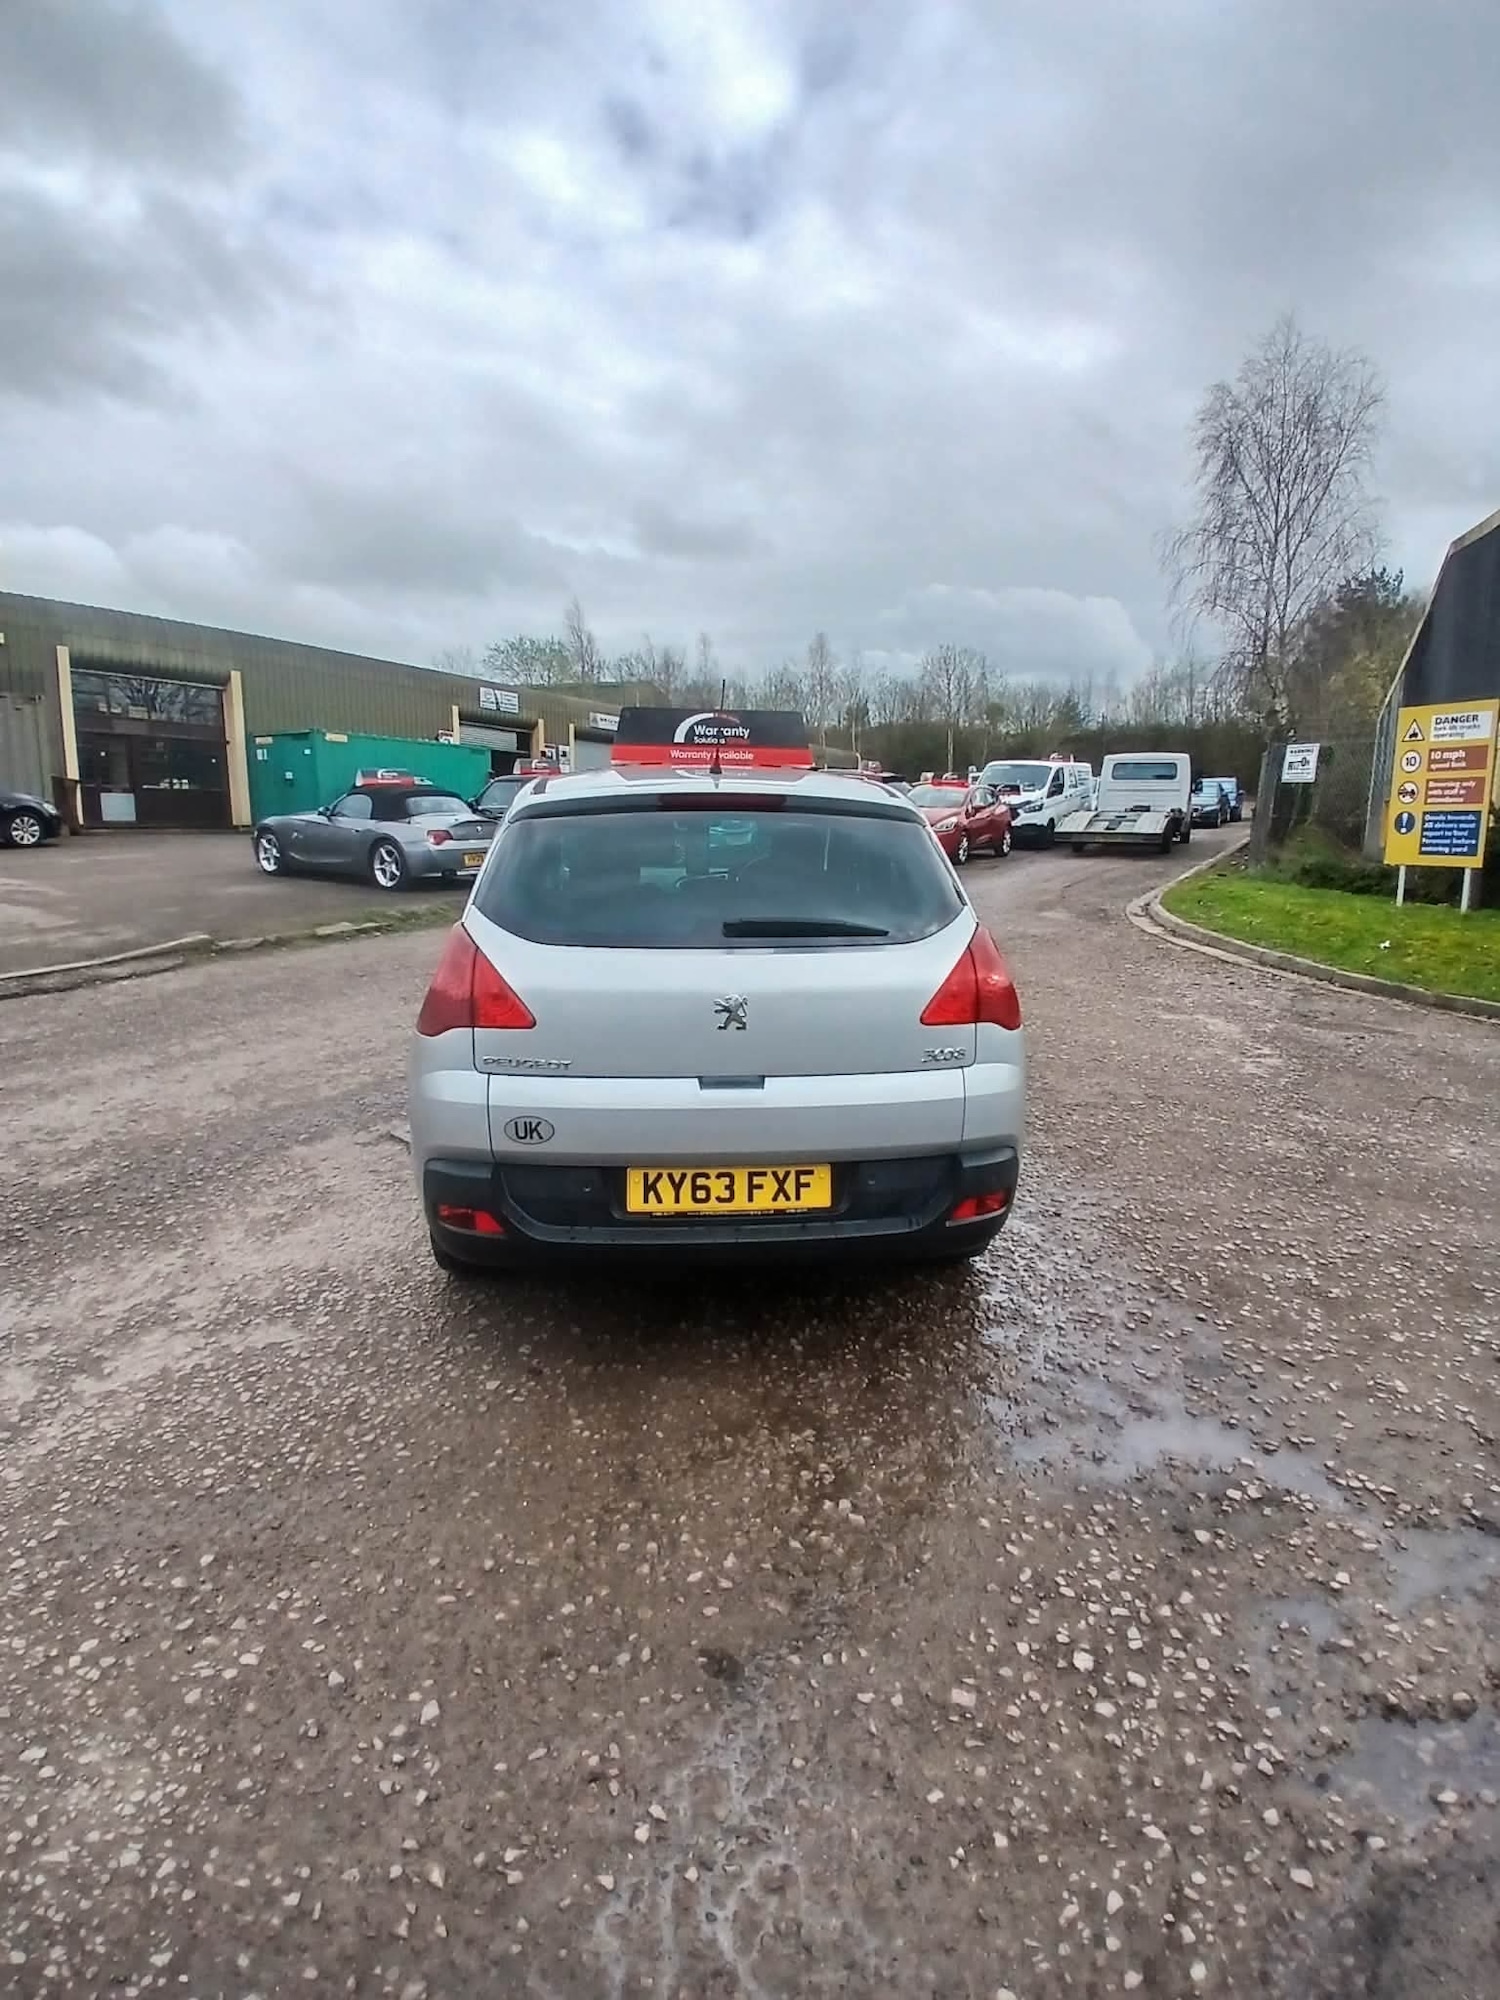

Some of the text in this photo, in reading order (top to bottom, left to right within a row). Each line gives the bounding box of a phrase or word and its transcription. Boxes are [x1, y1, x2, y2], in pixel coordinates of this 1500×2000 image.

[1435, 714, 1479, 725] DANGER
[670, 749, 711, 760] Warranty
[1430, 750, 1466, 760] 10 mph
[1406, 756, 1417, 766] 10
[482, 1055, 572, 1070] PEUGEOT
[514, 1121, 544, 1140] UK
[643, 1169, 814, 1204] KY63 FXF
